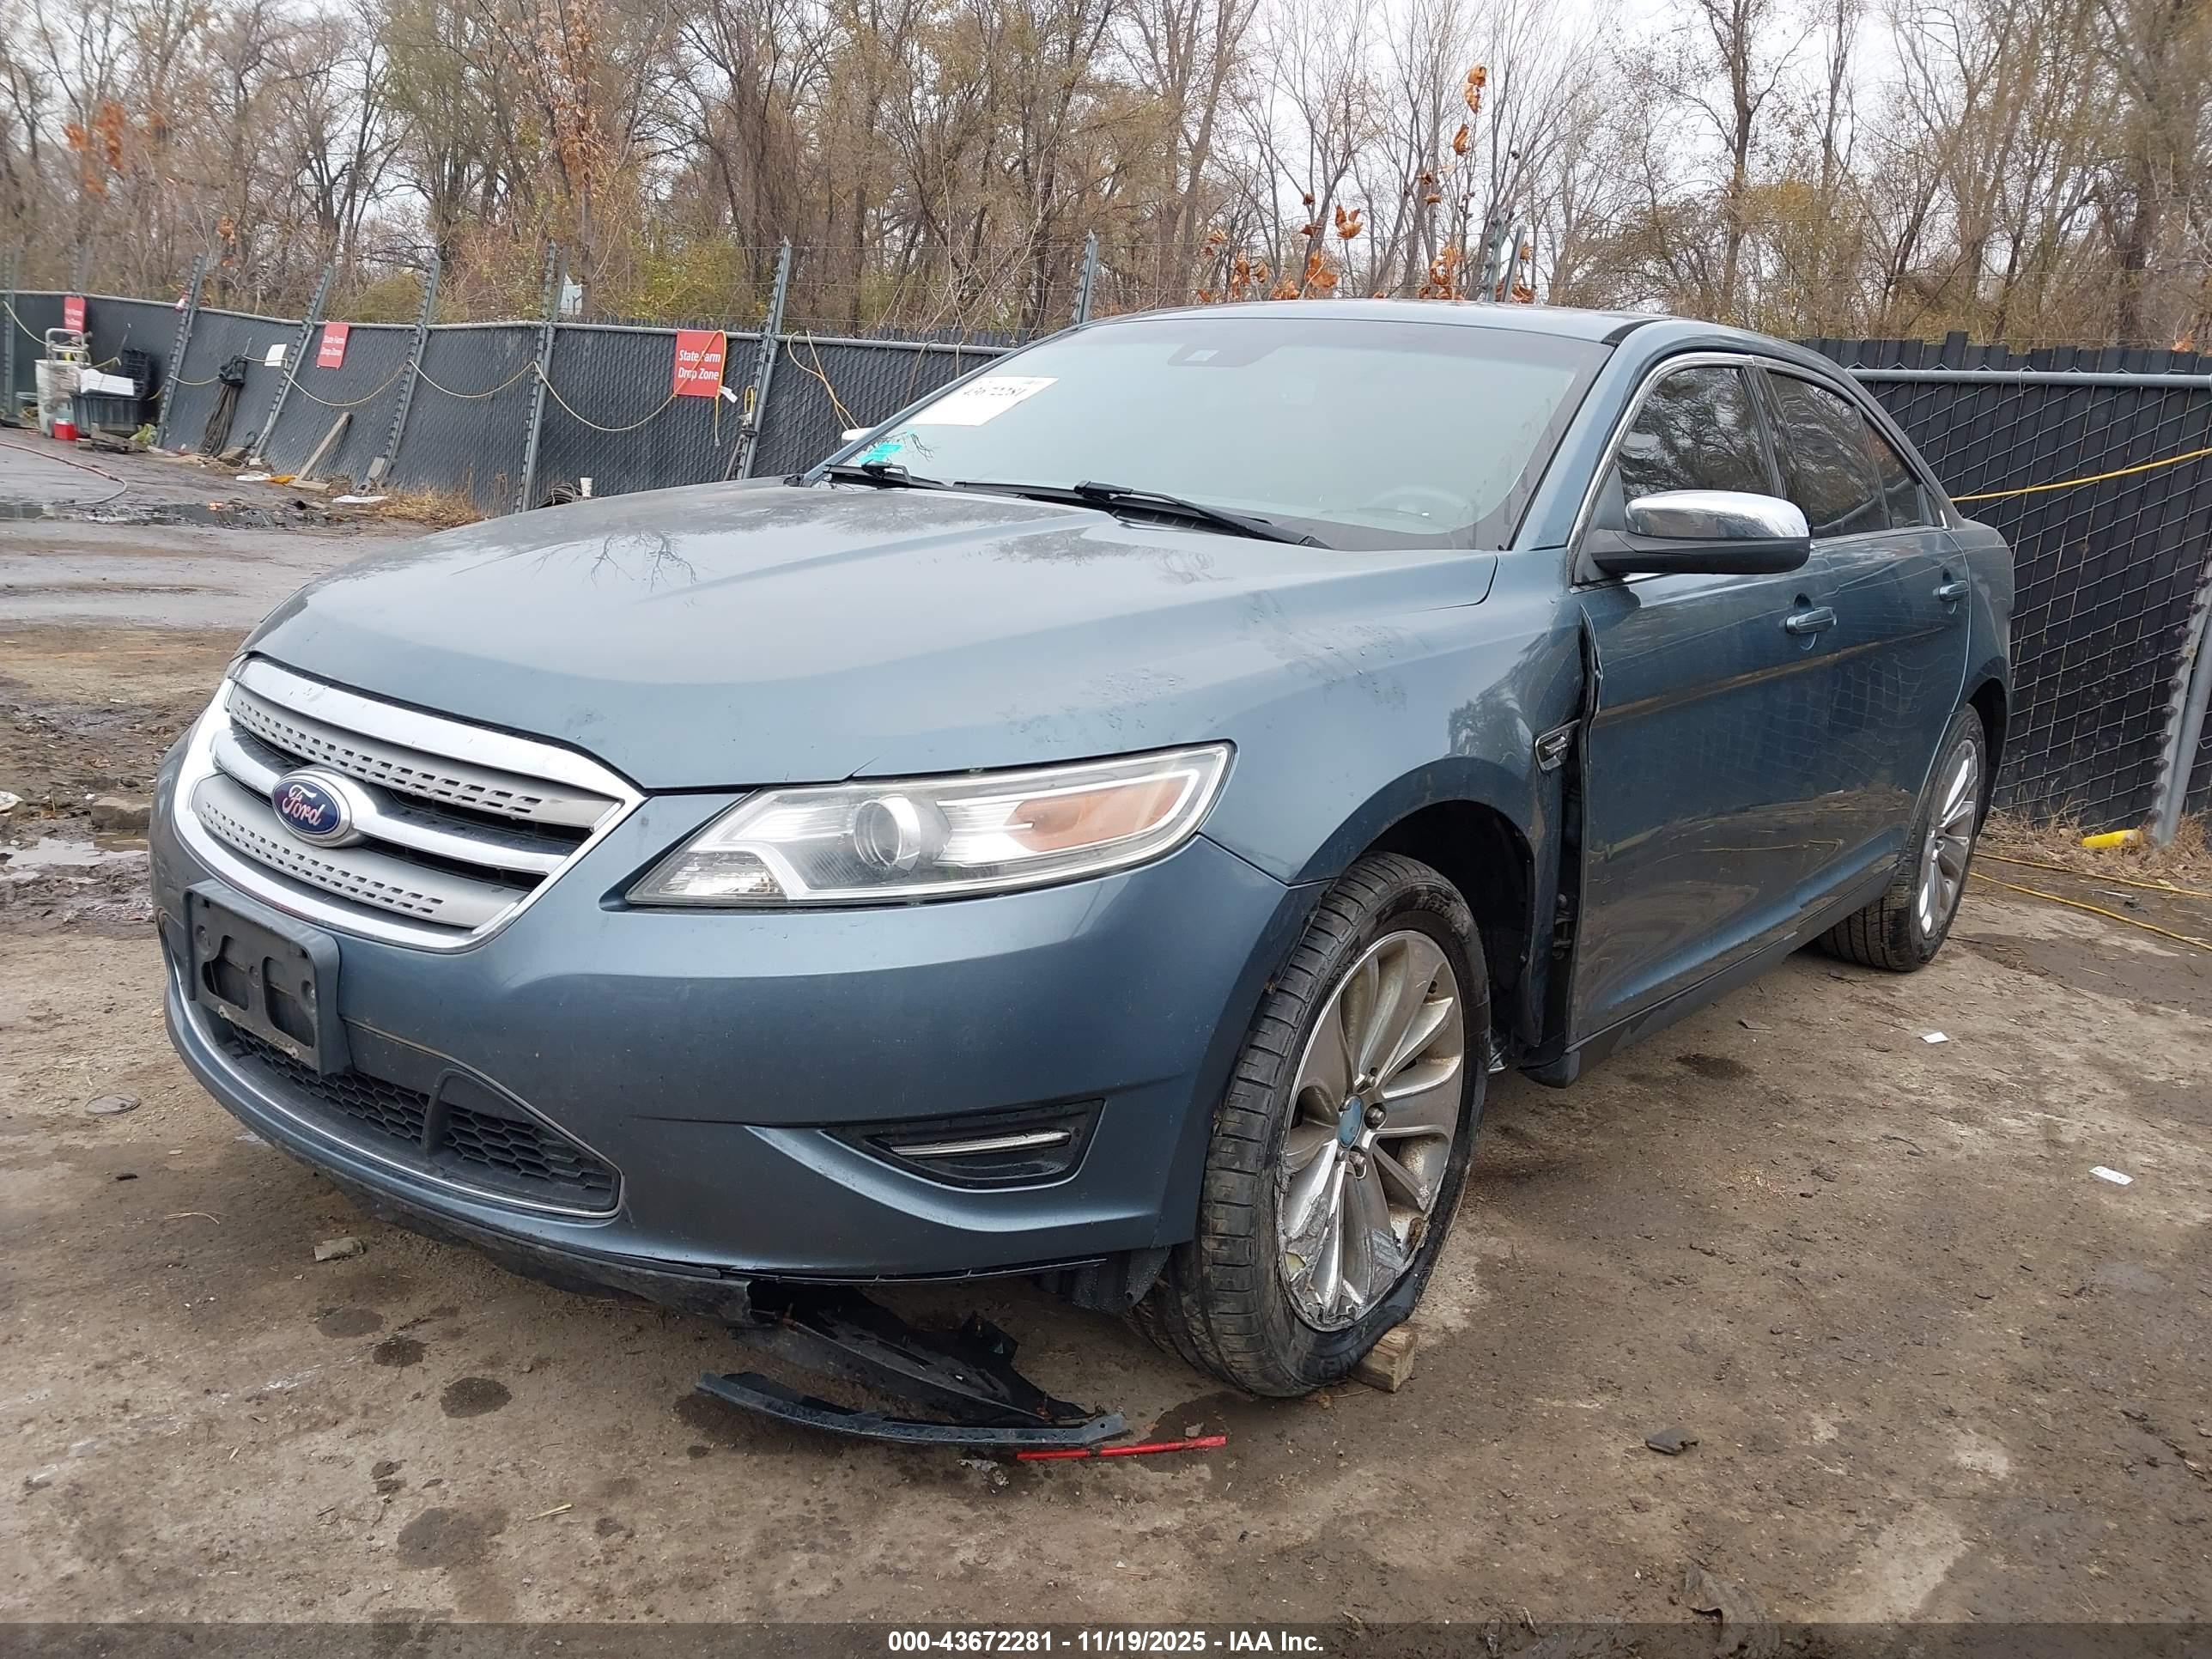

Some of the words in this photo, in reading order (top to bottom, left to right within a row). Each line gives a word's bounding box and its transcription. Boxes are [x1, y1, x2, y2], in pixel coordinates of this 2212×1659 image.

[678, 349, 700, 362] State
[698, 368, 720, 380] Zone
[282, 784, 325, 826] Ford
